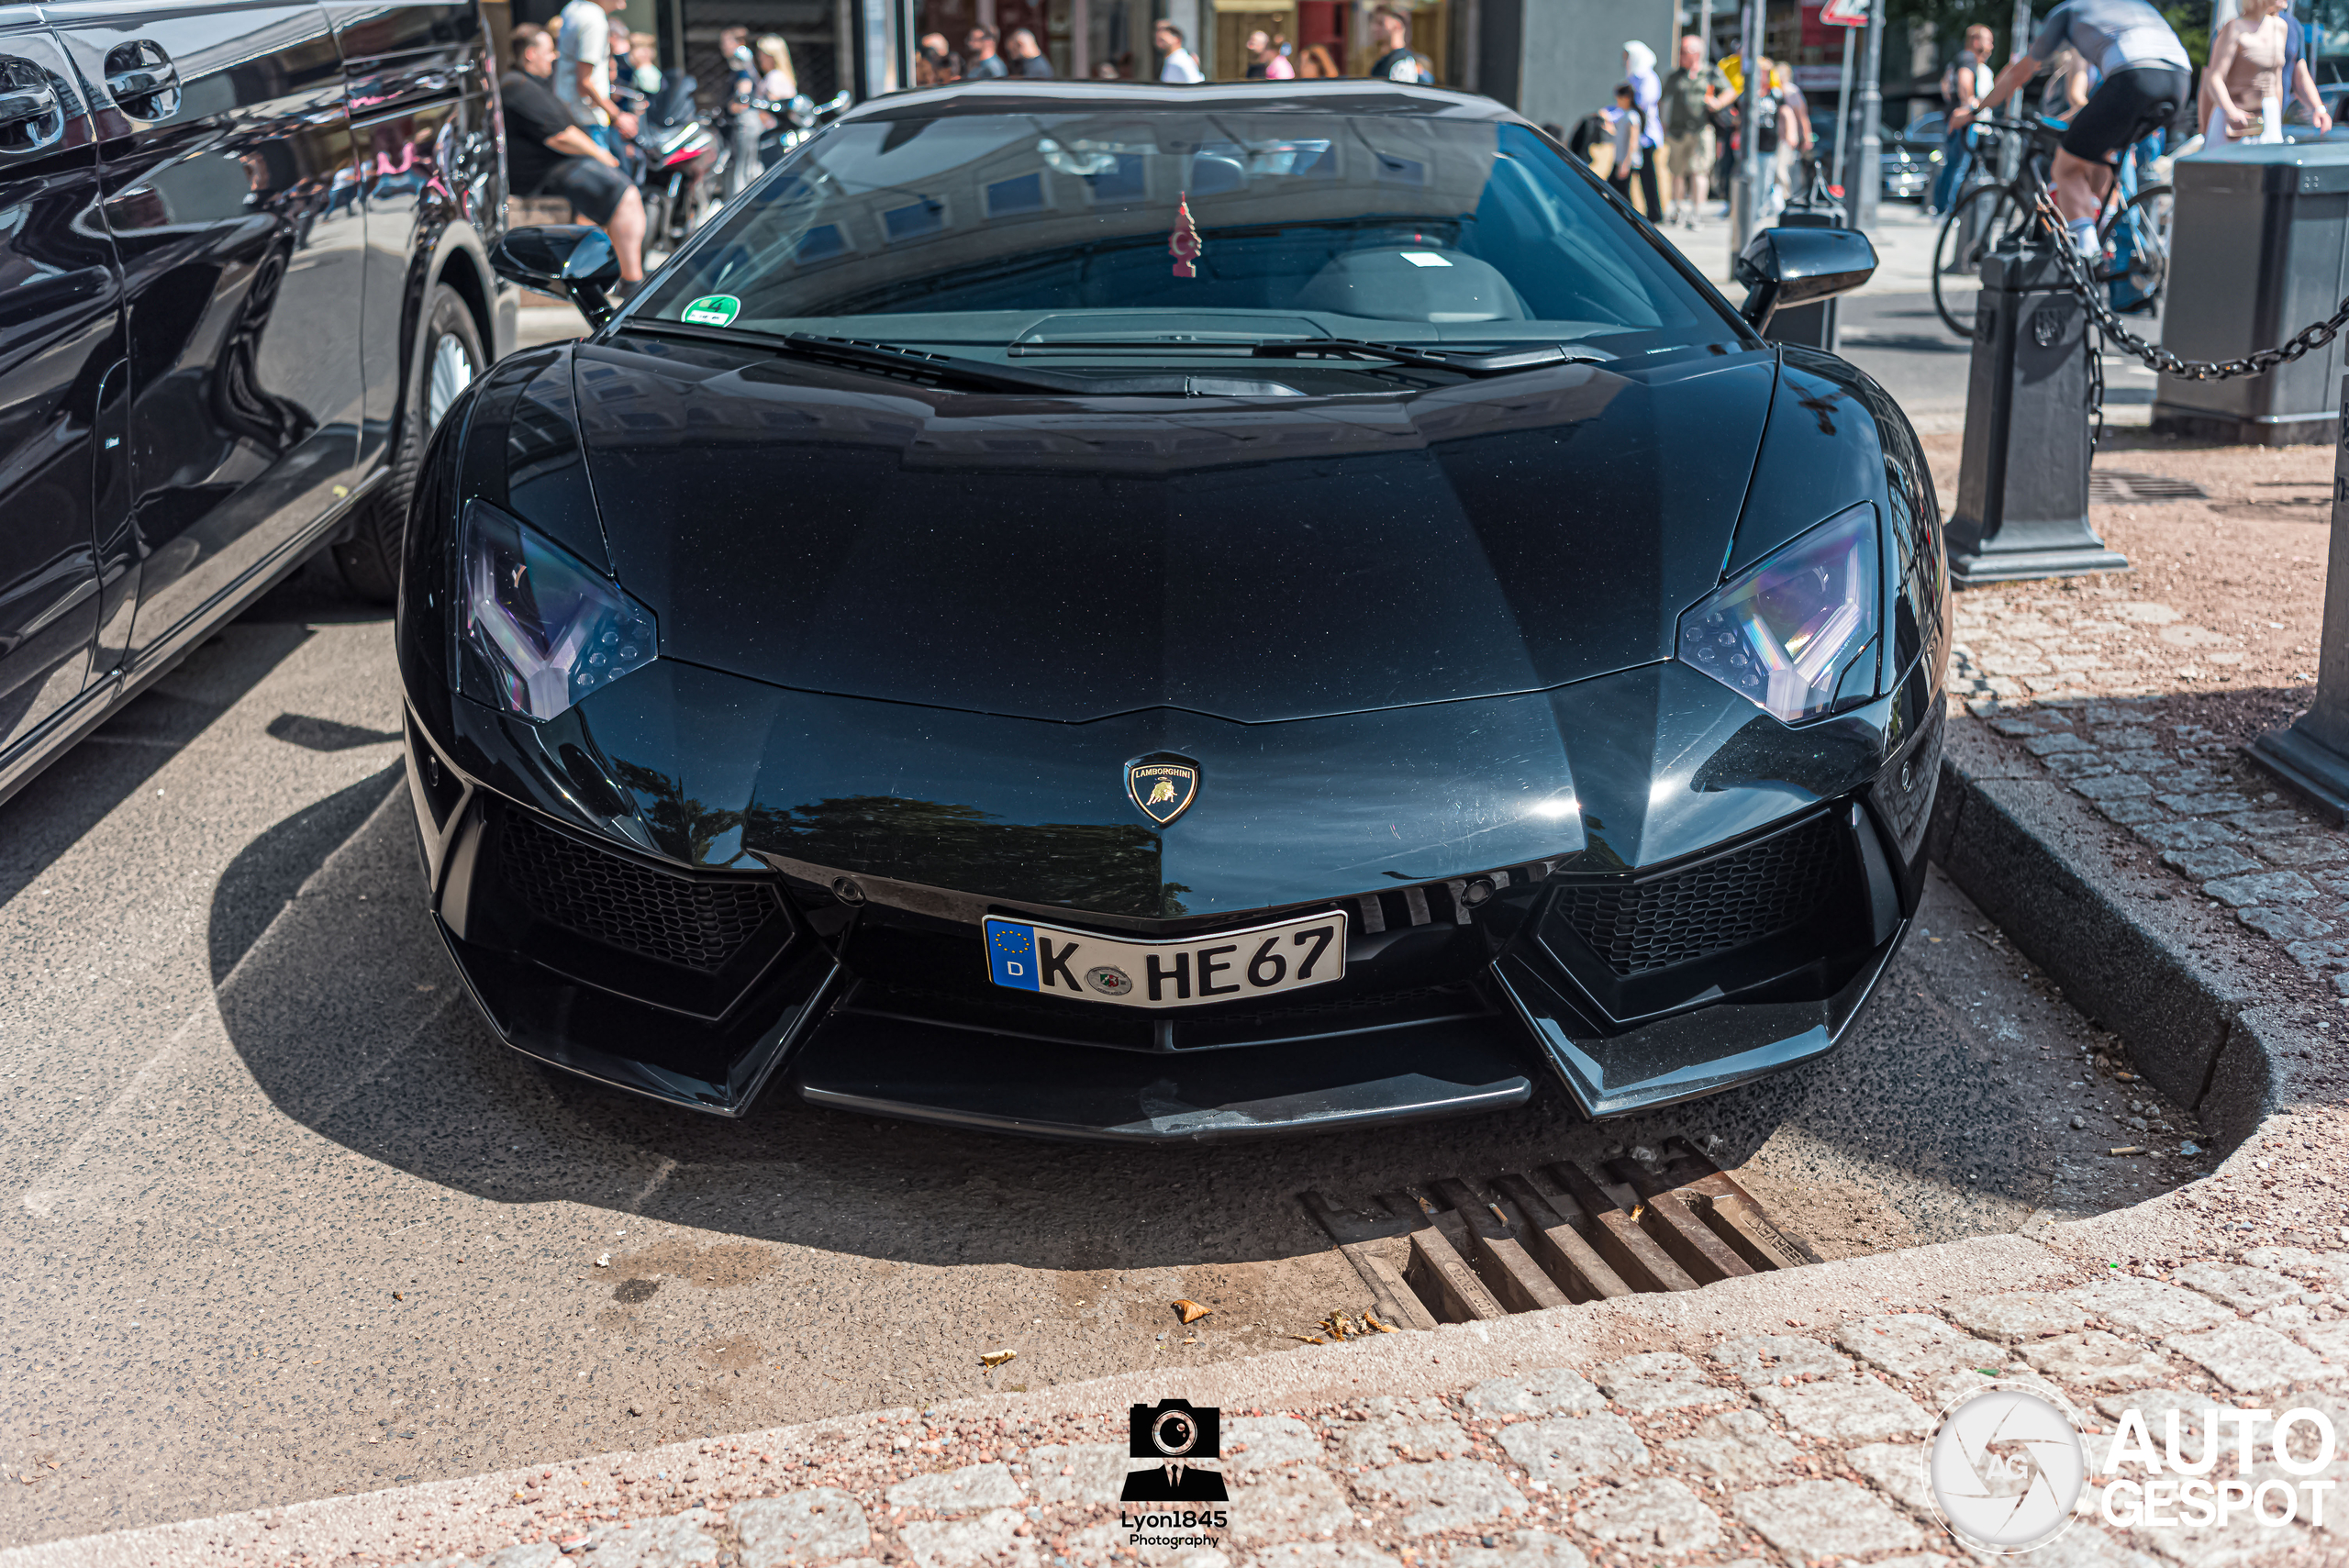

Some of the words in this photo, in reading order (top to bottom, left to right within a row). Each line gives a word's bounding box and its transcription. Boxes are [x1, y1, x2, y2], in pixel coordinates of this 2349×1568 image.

[707, 297, 726, 312] 4
[1135, 768, 1190, 779] LAMBORGHINI
[1008, 961, 1024, 976] D
[1039, 936, 1084, 992] K
[1145, 927, 1335, 1001] HE67
